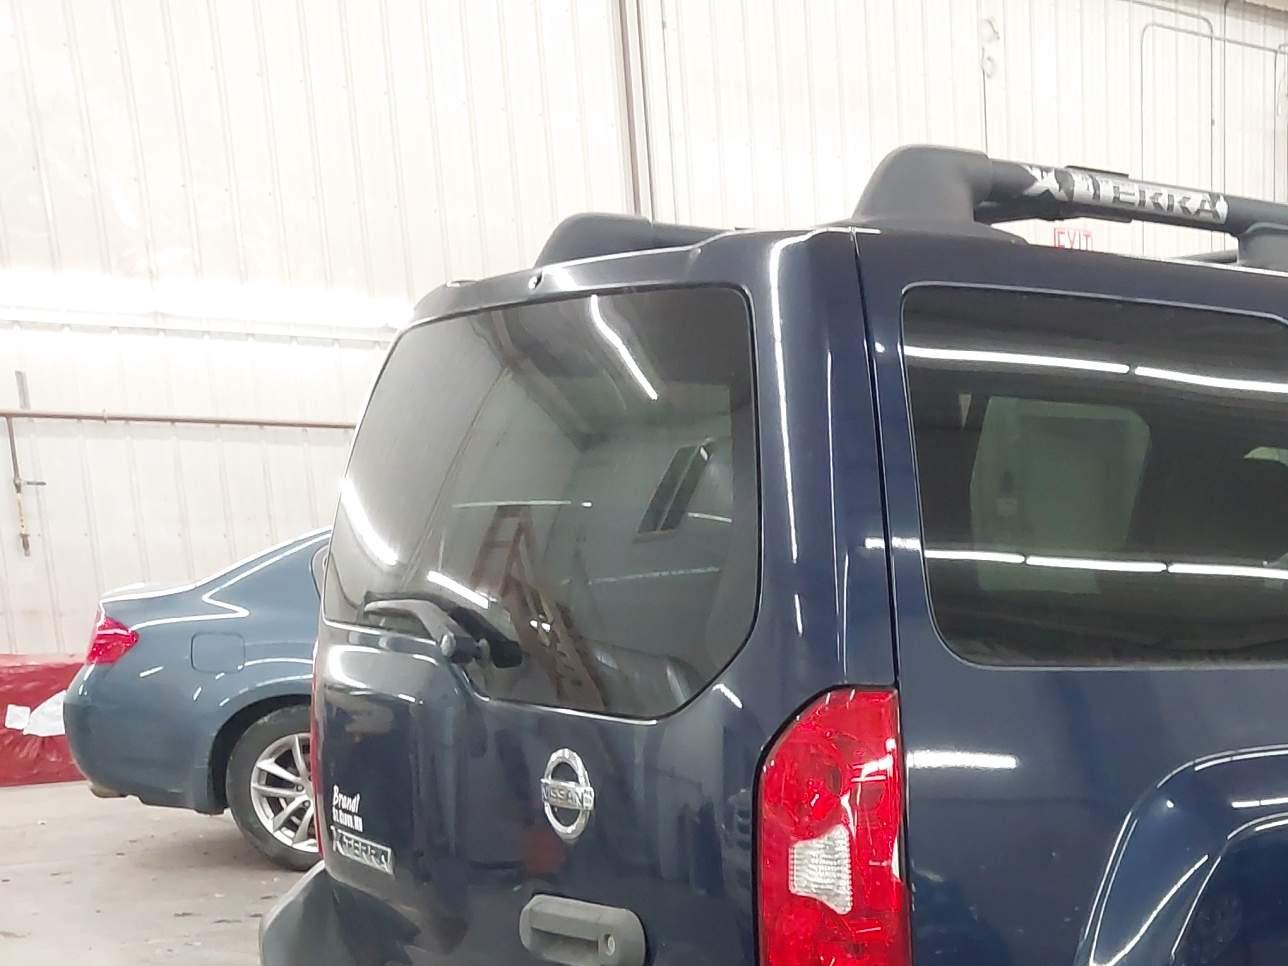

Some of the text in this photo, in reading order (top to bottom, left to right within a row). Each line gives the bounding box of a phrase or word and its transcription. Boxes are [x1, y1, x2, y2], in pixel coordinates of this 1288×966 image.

[1022, 163, 1230, 225] XTERRA
[541, 782, 585, 810] NISSAN
[330, 825, 393, 875] XTERRA
